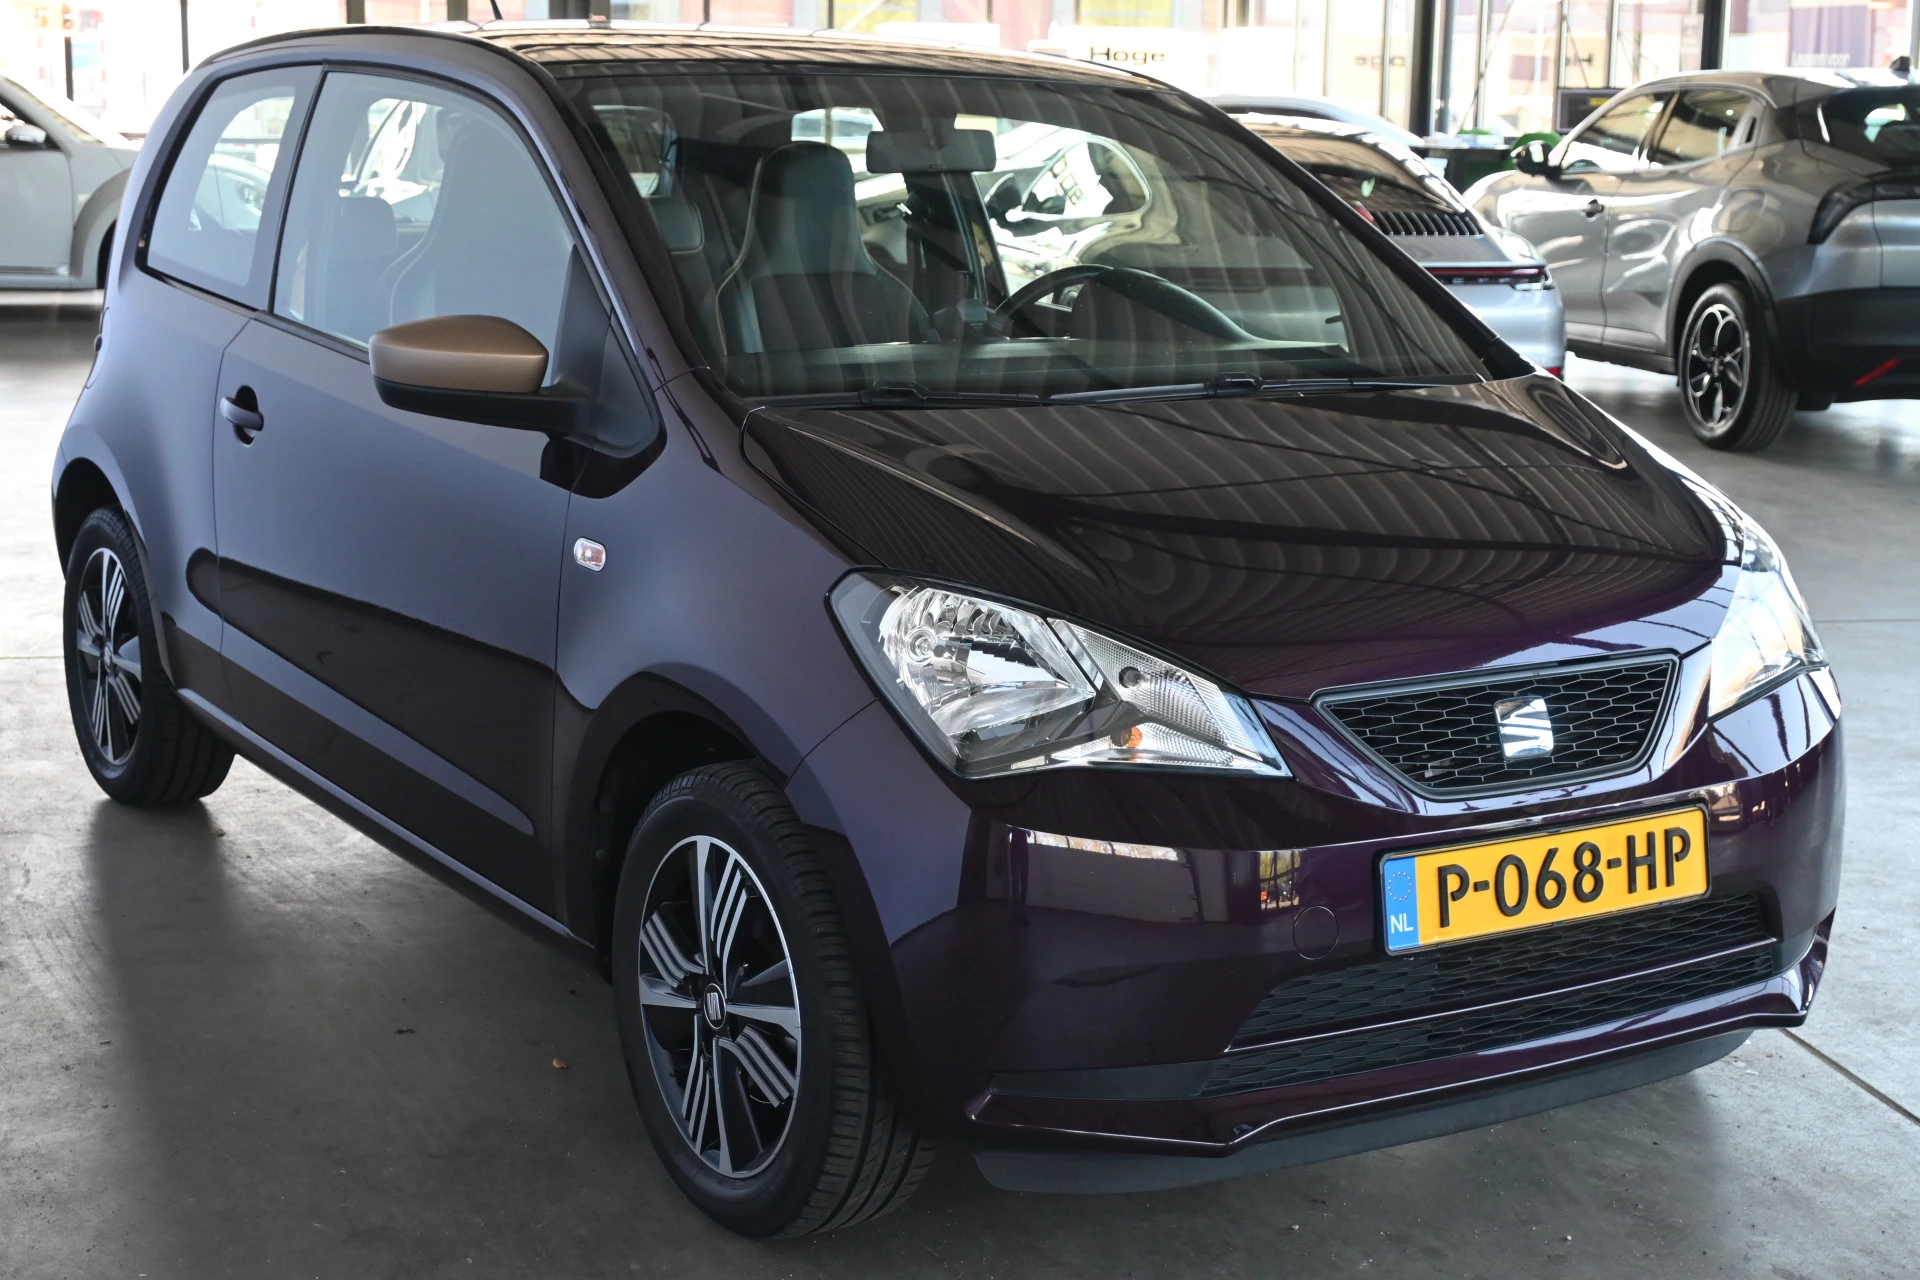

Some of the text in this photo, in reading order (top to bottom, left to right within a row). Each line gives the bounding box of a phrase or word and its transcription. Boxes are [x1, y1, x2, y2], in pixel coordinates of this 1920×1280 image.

[1089, 46, 1166, 66] Hoge
[1437, 826, 1692, 929] P-068-HP
[1390, 912, 1414, 934] NL
